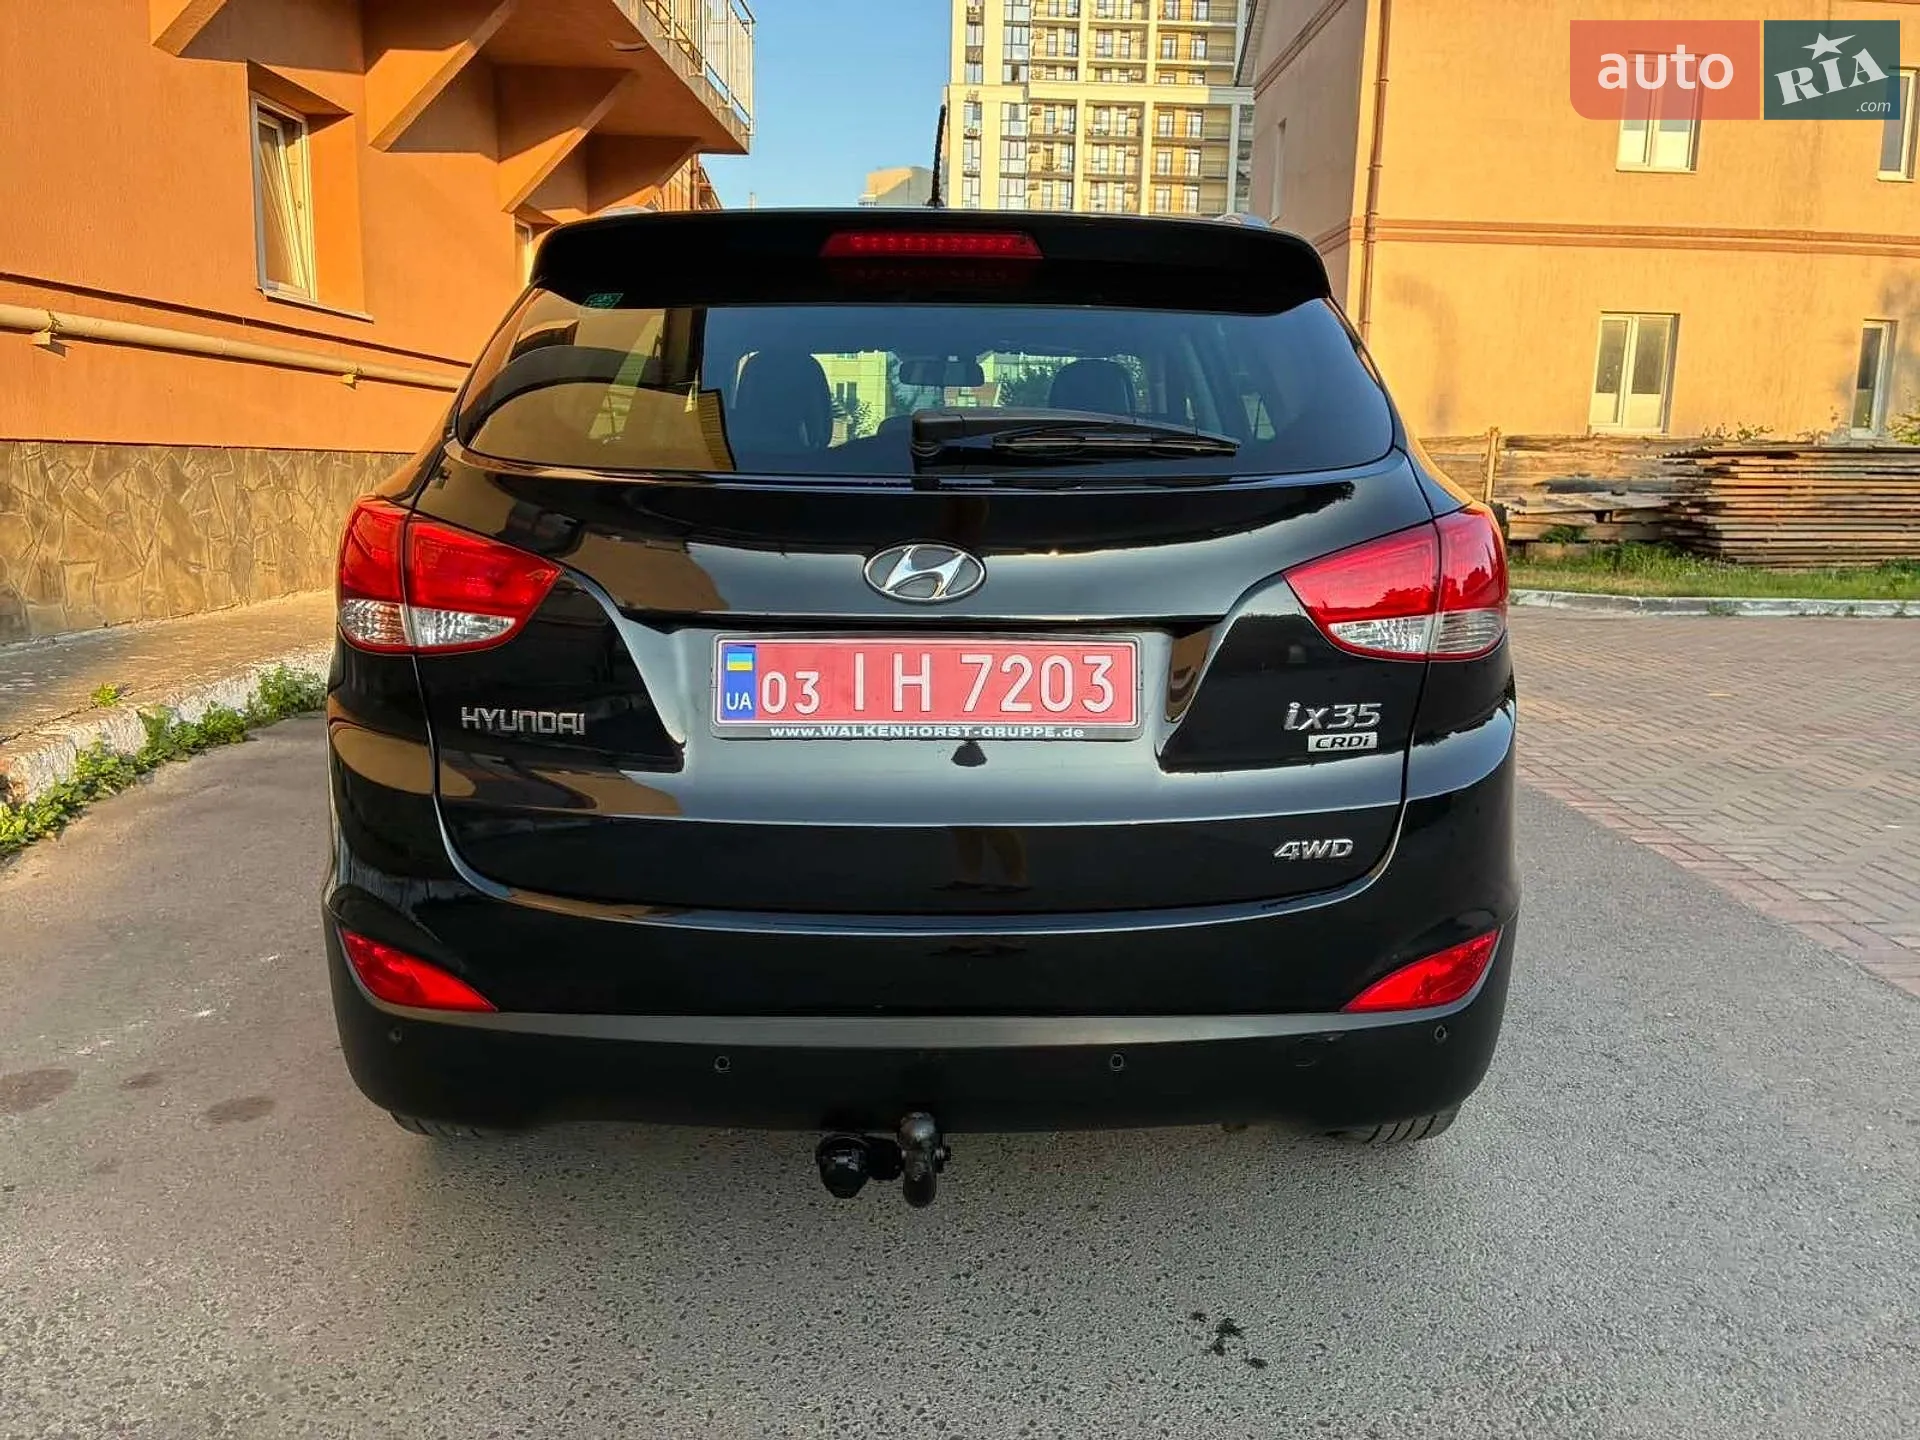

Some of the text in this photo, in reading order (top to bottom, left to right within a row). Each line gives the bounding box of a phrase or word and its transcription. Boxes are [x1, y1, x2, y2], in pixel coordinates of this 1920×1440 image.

[761, 671, 820, 715] 03
[959, 653, 1115, 713] 7203
[726, 692, 753, 711] UA
[461, 706, 586, 735] HYUNDAI
[1283, 702, 1383, 731] ix35
[769, 725, 1084, 739] www.WALKENHORST-GRUPPE.de
[1315, 735, 1370, 749] CRDi
[1273, 838, 1354, 861] 4WD
